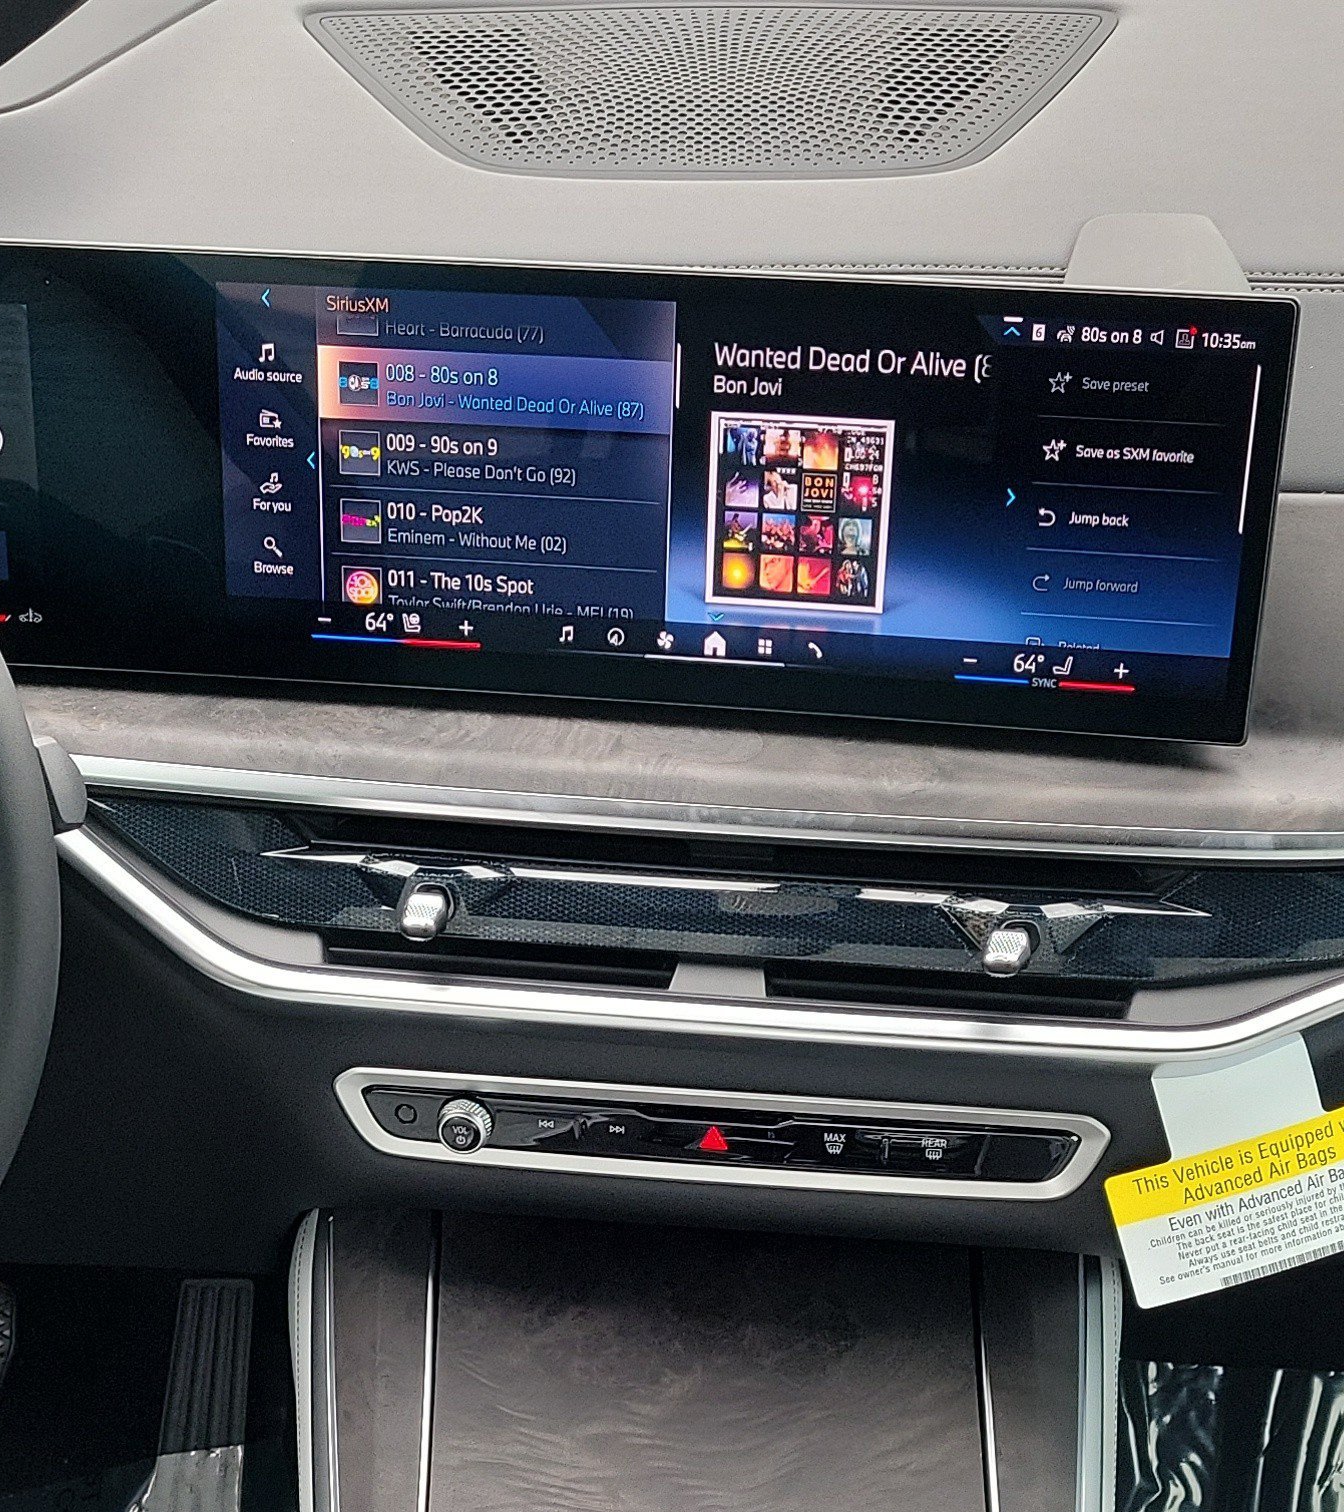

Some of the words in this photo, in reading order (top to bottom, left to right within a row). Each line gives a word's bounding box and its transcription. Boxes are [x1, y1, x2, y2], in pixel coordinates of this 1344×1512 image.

[326, 295, 389, 313] SiriusXM
[385, 320, 426, 337] Heart
[439, 321, 513, 341] Barracuda
[517, 324, 544, 344] (77)
[1081, 326, 1107, 343] 80s
[1110, 330, 1129, 344] on
[1132, 328, 1143, 345] 8
[714, 341, 801, 369] Wanted
[808, 346, 870, 372] Dead
[877, 349, 906, 374] Or
[910, 350, 966, 378] Alive
[234, 367, 265, 381] Audio
[267, 371, 303, 383] source
[386, 363, 415, 383] 008
[430, 365, 459, 384] 80s
[463, 371, 483, 386] on
[487, 368, 499, 386] 8
[713, 374, 748, 394] Bon
[750, 376, 783, 396] Jovi
[1082, 377, 1111, 391] Save
[1112, 379, 1150, 394] preset
[386, 390, 415, 407] Bon
[418, 391, 445, 409] Jovi
[458, 392, 513, 412] Wanted
[516, 396, 555, 414] Dead
[558, 398, 576, 415] Or
[578, 399, 613, 417] Alive
[617, 400, 645, 421] (87)
[246, 433, 295, 448] Favorites
[386, 433, 415, 452] 009
[430, 435, 459, 455] 90s
[463, 440, 483, 456] on
[487, 438, 498, 456] 9
[1076, 444, 1105, 460] Save
[1106, 448, 1121, 460] as
[1122, 446, 1150, 462] SXM
[1151, 448, 1195, 464] favorite
[387, 459, 420, 477] KWS
[433, 462, 481, 479] Please
[485, 464, 523, 482] Don't
[526, 466, 546, 483] Go
[550, 468, 576, 487] (92)
[252, 498, 271, 511] For
[272, 502, 292, 514] you
[387, 501, 416, 521] 010
[431, 504, 484, 526] Pop2K
[1069, 511, 1100, 528] Jump
[1102, 513, 1130, 528] back
[387, 527, 445, 546] Eminem
[458, 531, 513, 550] Without
[515, 534, 537, 551] Me
[540, 535, 567, 555] (02)
[254, 561, 294, 575] Browse
[387, 569, 415, 589] 011
[430, 572, 462, 591] The
[464, 574, 493, 592] 10s
[496, 576, 535, 596] Spot
[1063, 577, 1094, 593] Jump
[1095, 579, 1138, 594] forward
[1031, 677, 1058, 689] SYNC
[452, 1125, 470, 1135] VOL
[823, 1132, 847, 1143] MAX
[921, 1137, 948, 1149] REAR
[1132, 1173, 1170, 1195] This
[1172, 1155, 1234, 1184] Vehicle
[1237, 1149, 1254, 1166] is
[1257, 1120, 1334, 1160] Equipped
[1183, 1165, 1263, 1205] Advanced
[1269, 1159, 1291, 1179] Air
[1296, 1145, 1337, 1170] Bags
[1168, 1213, 1203, 1232] Even
[1204, 1201, 1235, 1222] with
[1238, 1179, 1303, 1213] Advanced
[1307, 1173, 1325, 1191] Air
[1150, 1232, 1186, 1248] Children
[1218, 1215, 1241, 1229] killed
[1255, 1200, 1294, 1219] seriously
[1296, 1189, 1325, 1206] injured
[1176, 1239, 1193, 1251] The
[1194, 1233, 1215, 1246] back
[1216, 1227, 1235, 1240] seat
[1247, 1221, 1261, 1231] the
[1262, 1212, 1289, 1226] safest
[1290, 1205, 1312, 1219] place
[1178, 1247, 1203, 1261] Never
[1229, 1225, 1276, 1247] rear-facing
[1277, 1218, 1298, 1232] child
[1300, 1212, 1318, 1224] seat
[1188, 1252, 1219, 1268] Always
[1238, 1241, 1257, 1254] seat
[1258, 1235, 1279, 1250] belts
[1298, 1221, 1319, 1235] child
[1159, 1275, 1175, 1286] See
[1177, 1265, 1211, 1281] owner's
[1212, 1255, 1244, 1271] manual
[1260, 1244, 1283, 1257] more
[1284, 1227, 1333, 1249] information
